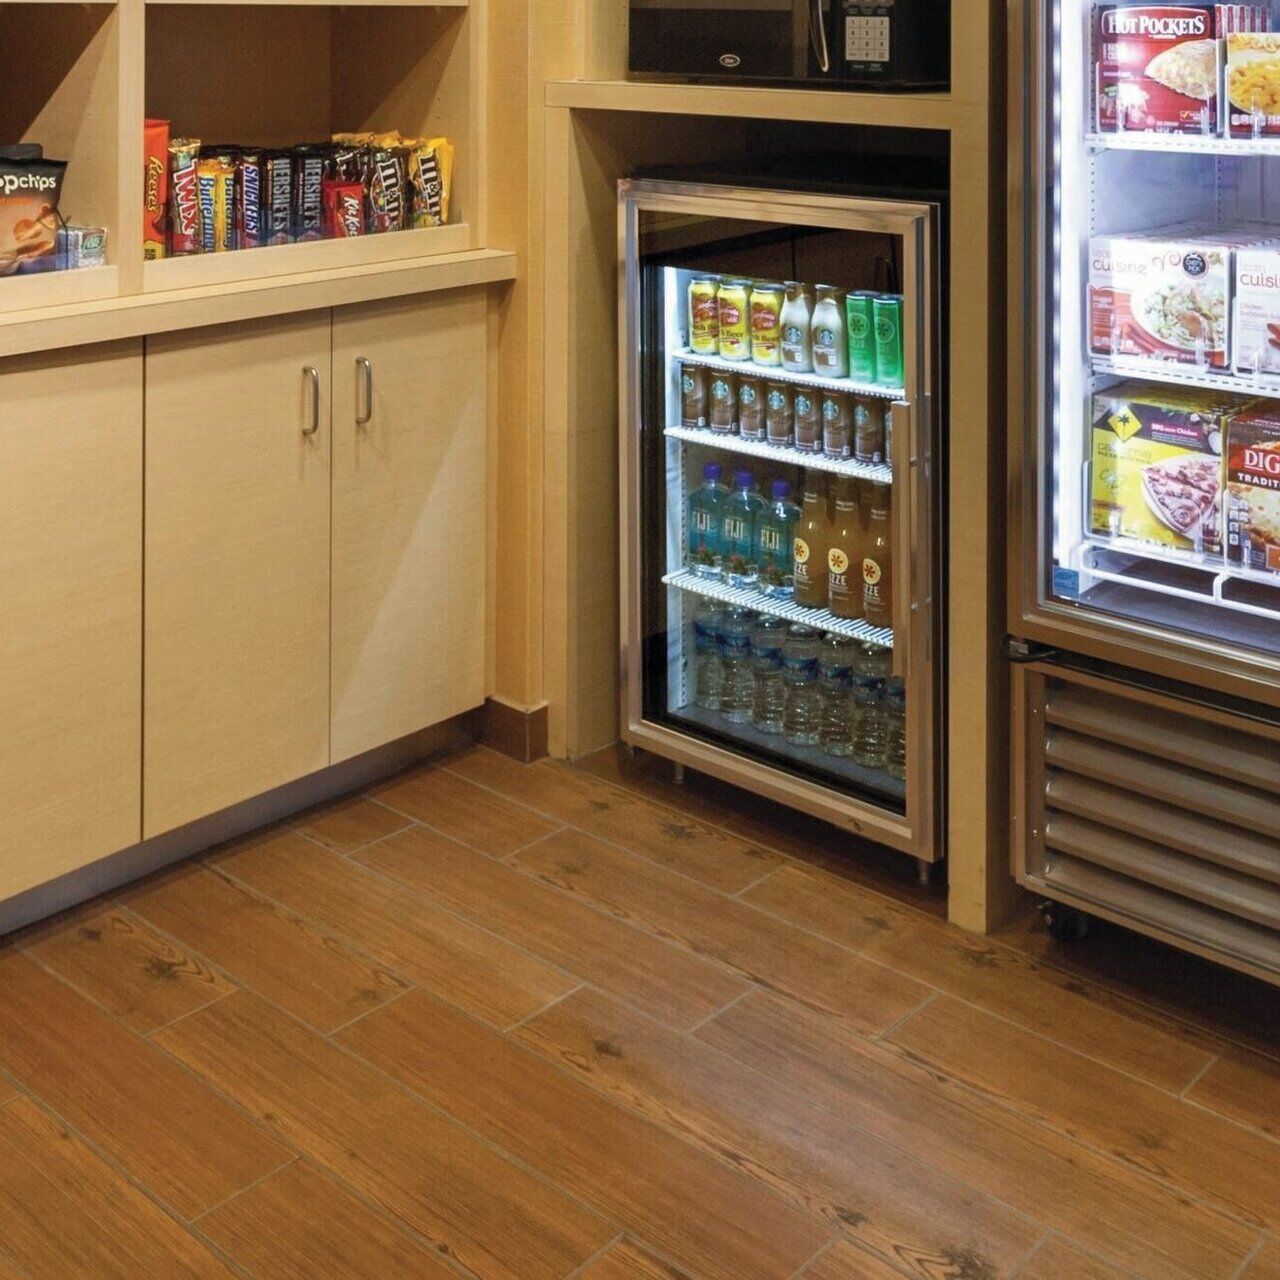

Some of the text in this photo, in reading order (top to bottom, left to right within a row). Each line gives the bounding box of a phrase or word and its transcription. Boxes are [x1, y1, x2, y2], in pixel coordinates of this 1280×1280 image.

[1108, 16, 1206, 35] HOT POCKETS
[147, 156, 165, 213] Reese's
[174, 158, 199, 235] TWIX
[243, 163, 260, 235] SNICKERS
[1092, 258, 1147, 275] cuisine
[692, 510, 711, 532] FIJI
[725, 517, 744, 539] FIJI
[761, 527, 780, 550] FIJI
[829, 574, 847, 586] IZZE
